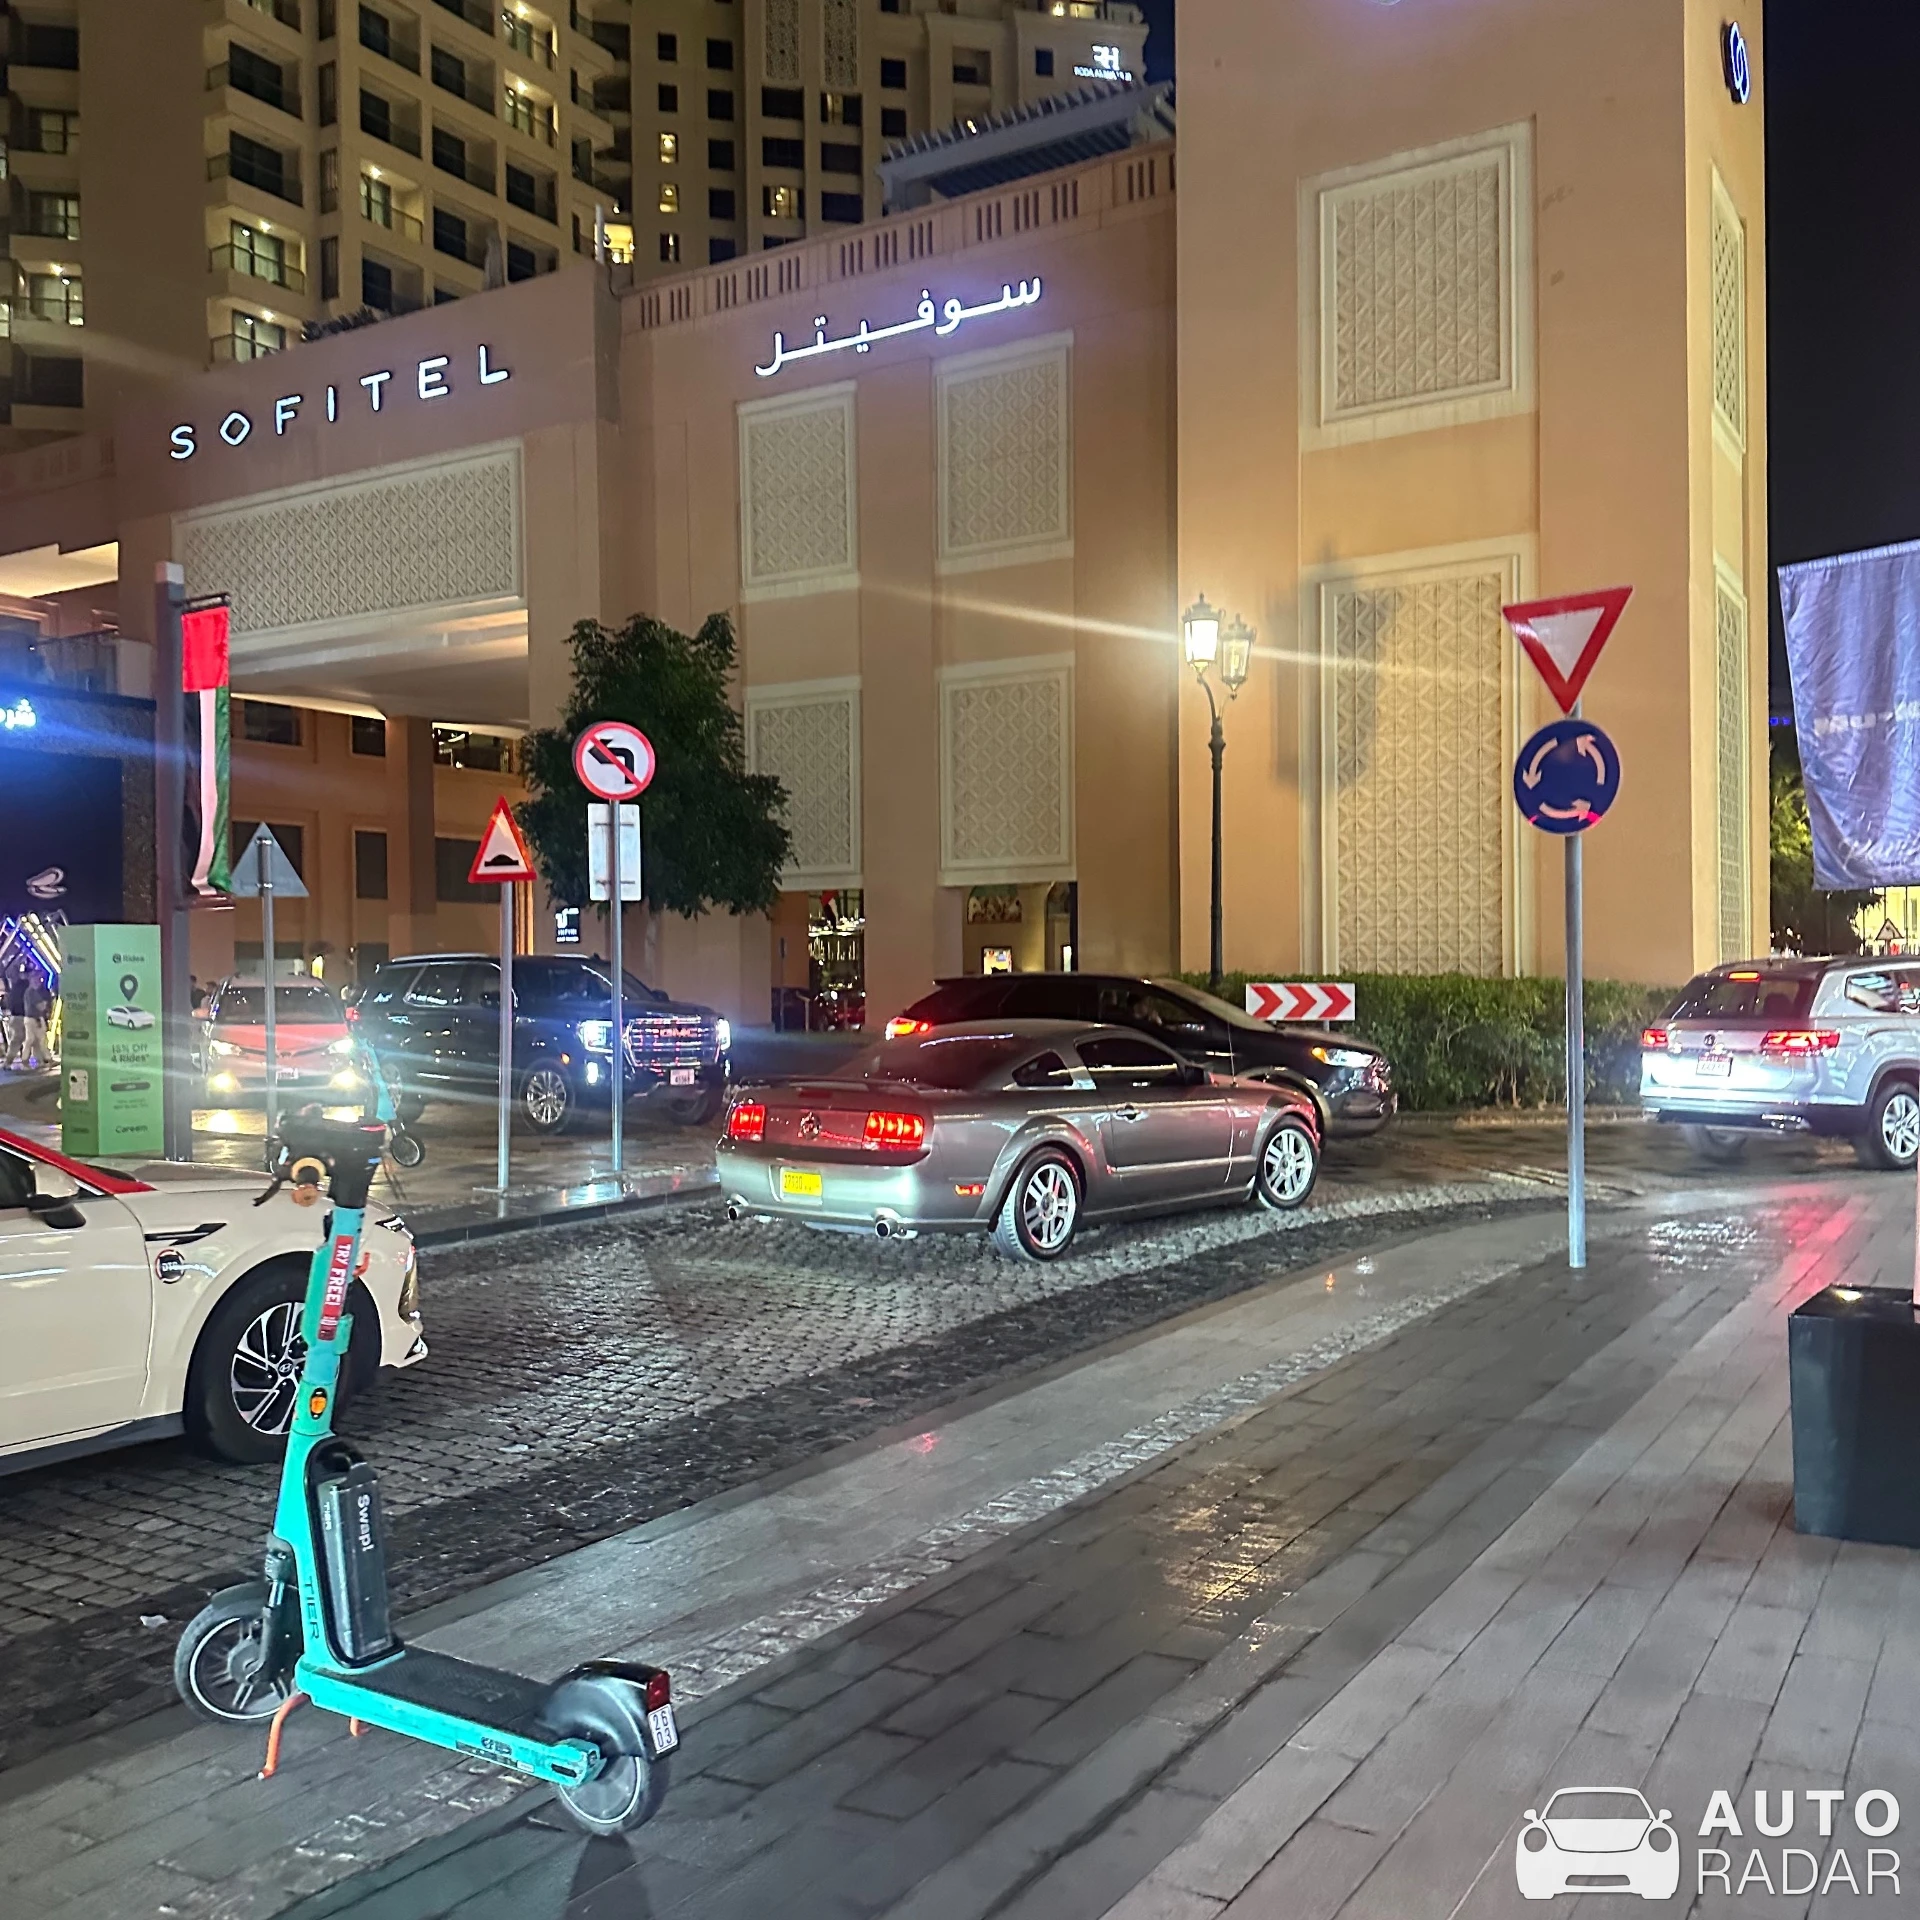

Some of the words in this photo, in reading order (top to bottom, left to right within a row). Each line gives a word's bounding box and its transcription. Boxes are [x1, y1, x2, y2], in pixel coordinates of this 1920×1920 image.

[755, 277, 1041, 376] سوفيتل
[170, 344, 510, 460] SOFITEL
[115, 1124, 148, 1134] Careem
[335, 1243, 351, 1265] TRY
[324, 1267, 347, 1306] FREE!
[357, 1494, 375, 1552] Swap!
[303, 1575, 320, 1640] TIER
[652, 1710, 669, 1731] 26
[656, 1727, 672, 1748] 03
